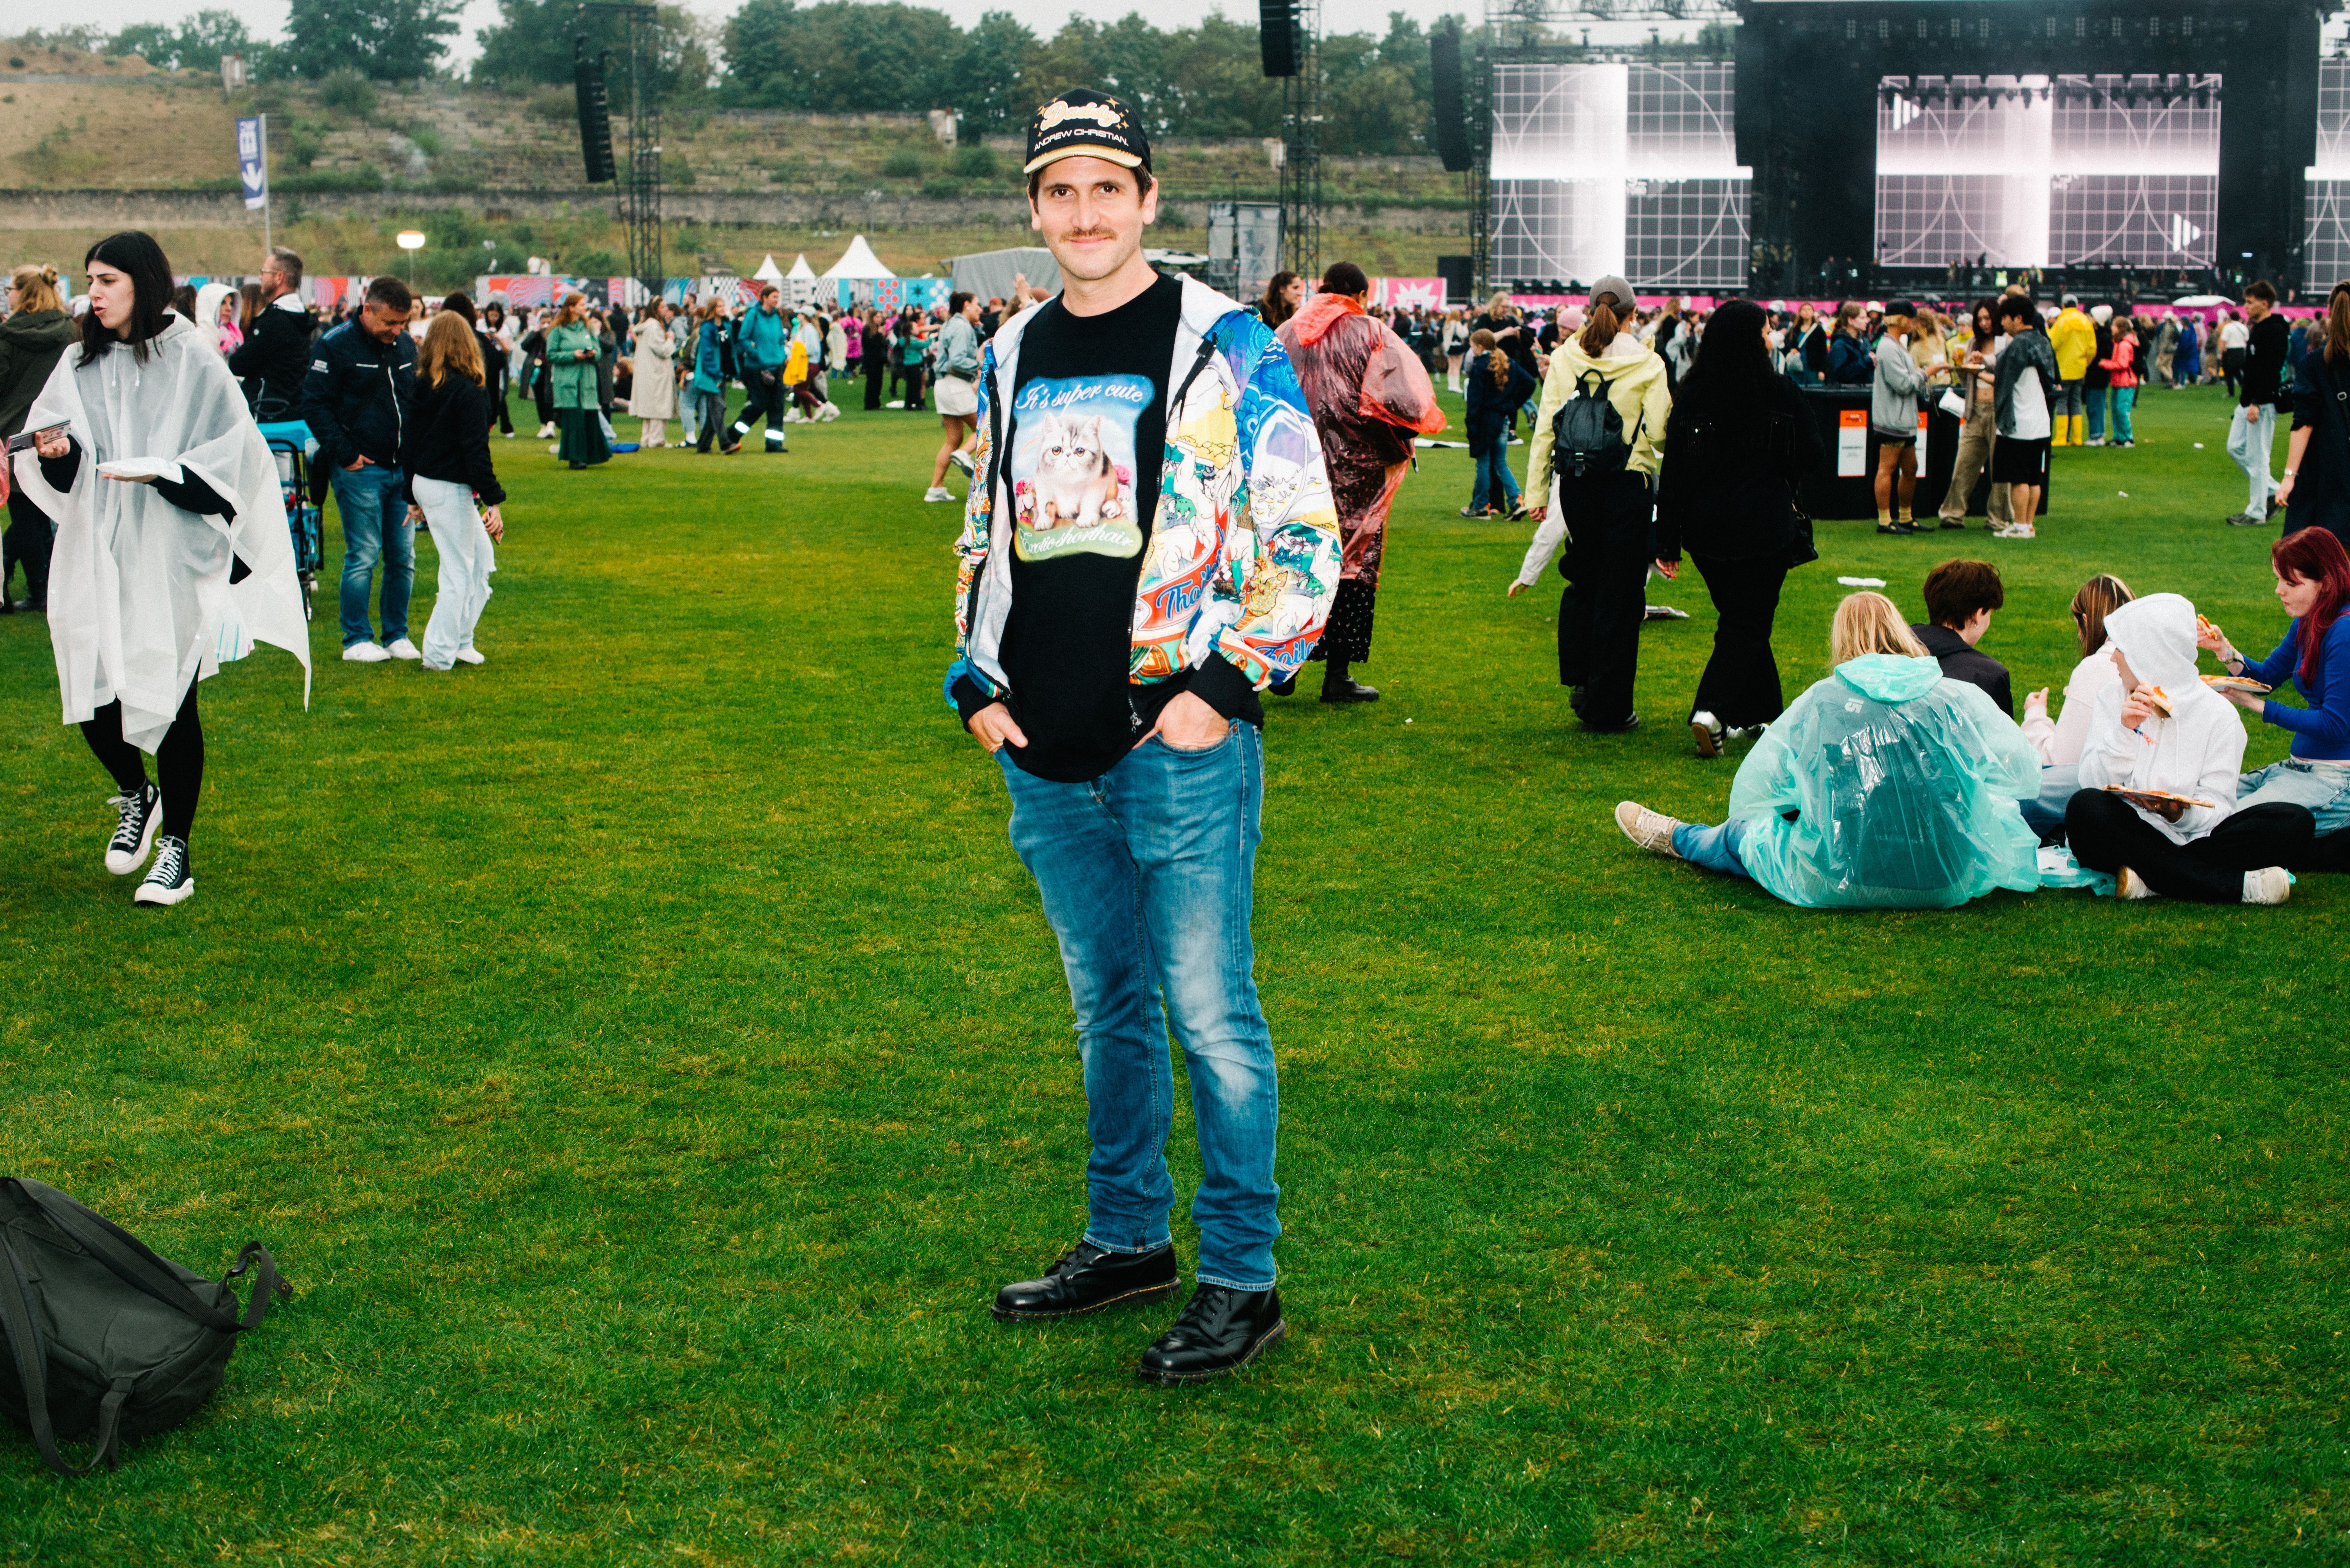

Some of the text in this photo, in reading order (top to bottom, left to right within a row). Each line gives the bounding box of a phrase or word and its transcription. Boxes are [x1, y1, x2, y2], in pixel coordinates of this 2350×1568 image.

[1041, 101, 1121, 131] Daddy
[1034, 130, 1072, 152] ANDREW
[1015, 383, 1143, 415] It's super cute
[1056, 523, 1135, 547] shorthair
